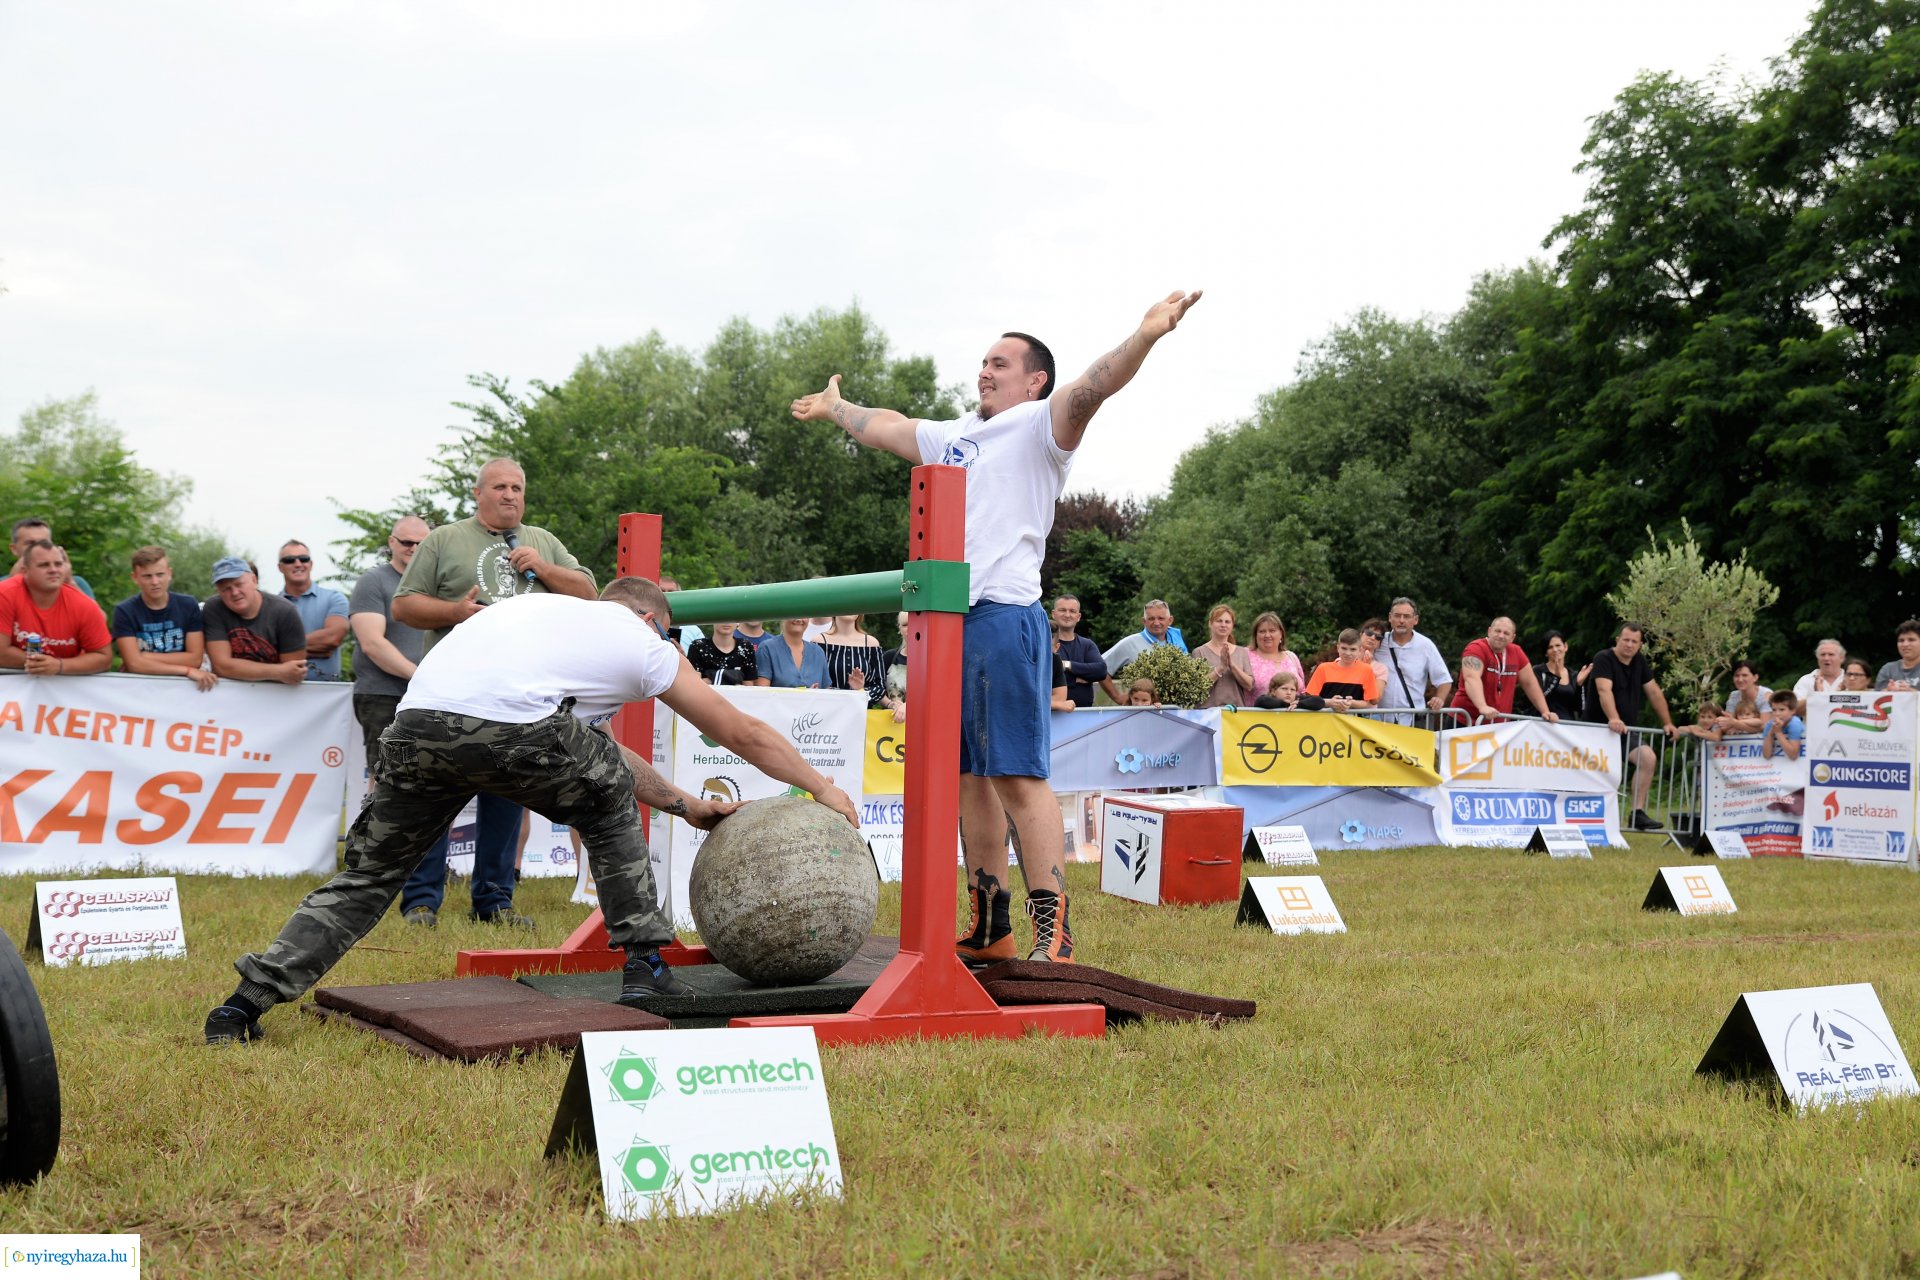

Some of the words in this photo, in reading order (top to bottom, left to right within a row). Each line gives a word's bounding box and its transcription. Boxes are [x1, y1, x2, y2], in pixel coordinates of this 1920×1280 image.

[33, 704, 155, 748] KERTI
[1298, 734, 1352, 764] Opel
[1503, 741, 1610, 773] Lukácsablak
[693, 754, 750, 765] HerbaDoc
[1145, 752, 1182, 768] NAPÉP
[1832, 767, 1907, 783] KINGSTORE
[1473, 798, 1552, 820] RUMED
[1568, 800, 1602, 814] SKF
[1844, 803, 1898, 819] netkazán
[1366, 825, 1404, 840] NAPÉP
[83, 889, 171, 905] CELLSPAN
[1271, 912, 1338, 926] Lukácsablak
[87, 929, 177, 945] CELLSPAN
[676, 1057, 815, 1095] gemtech
[703, 1087, 719, 1095] steel
[721, 1086, 756, 1094] structures
[757, 1085, 772, 1093] and
[773, 1084, 808, 1093] machinery
[690, 1142, 831, 1184] gemtech
